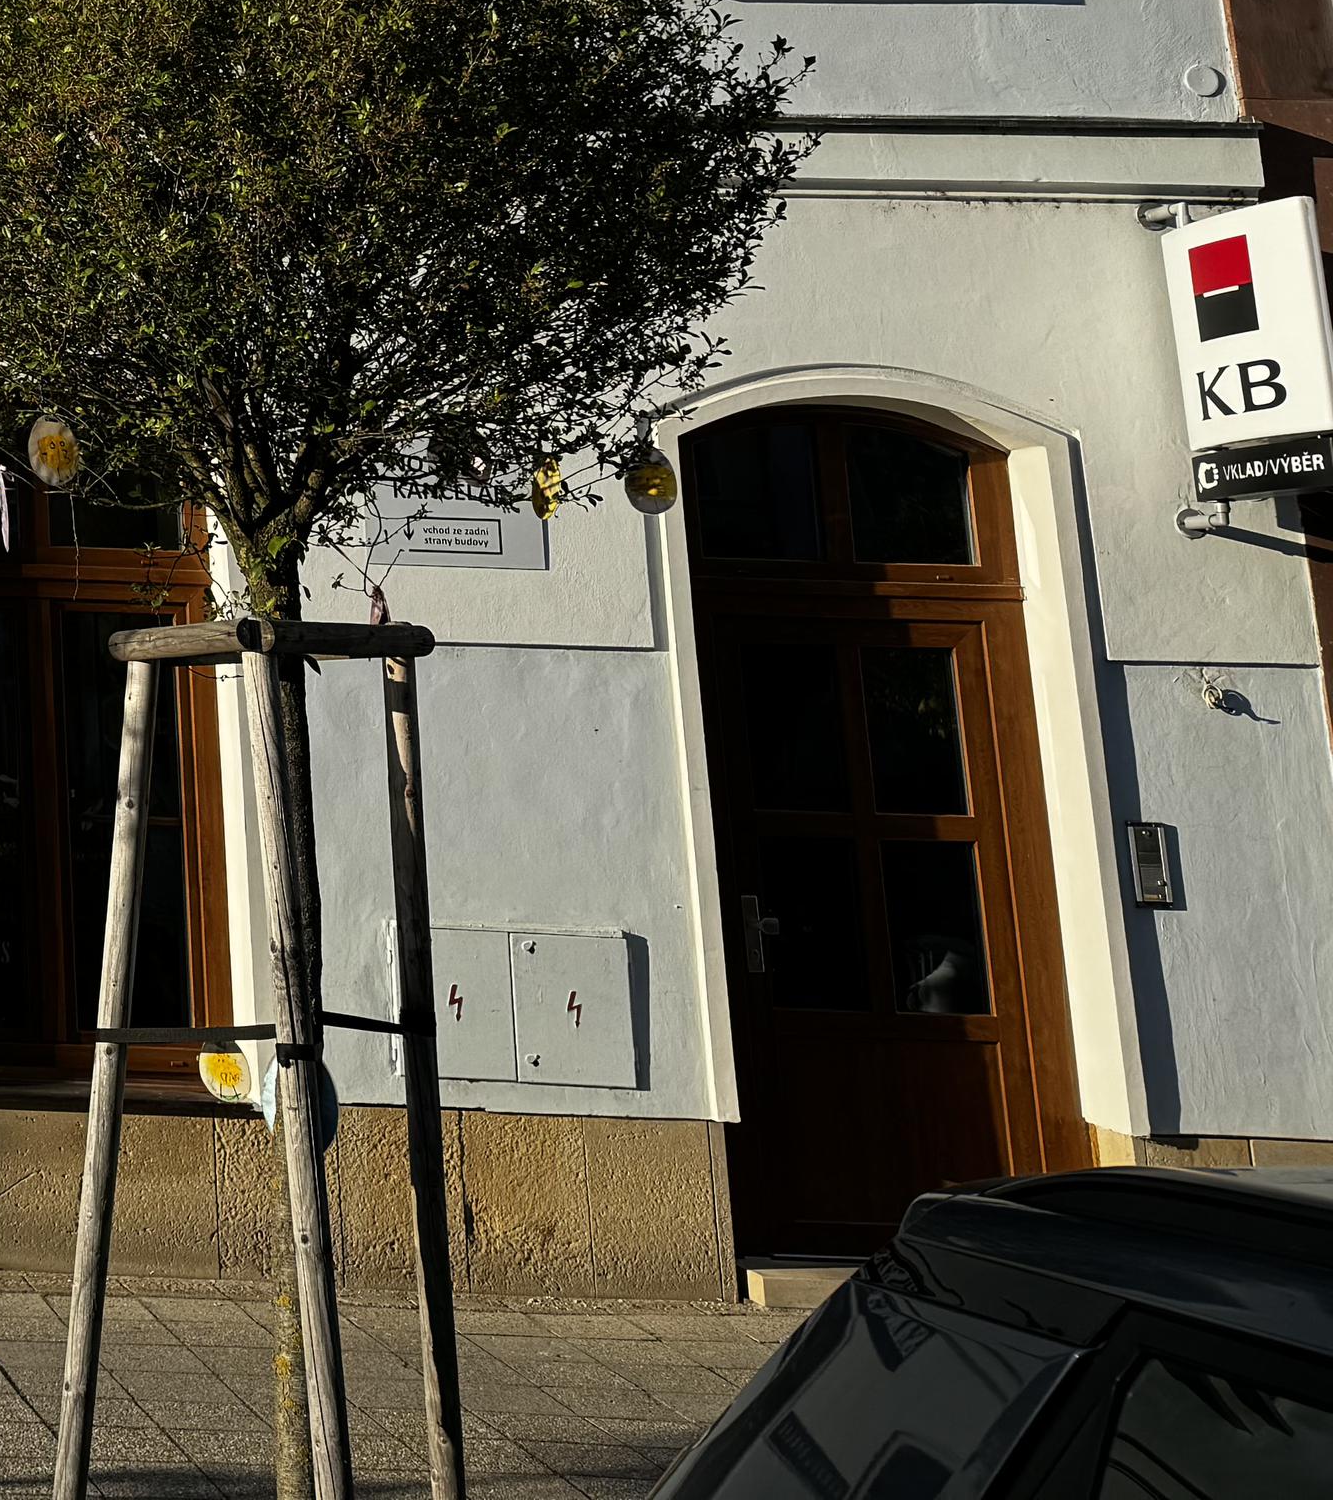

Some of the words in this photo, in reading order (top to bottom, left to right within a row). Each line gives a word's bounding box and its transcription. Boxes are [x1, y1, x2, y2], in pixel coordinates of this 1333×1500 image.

[1196, 358, 1287, 421] KB
[1222, 451, 1325, 481] VKLAD/VÝBĚR
[423, 526, 449, 535] vchod
[424, 538, 452, 548] strany
[454, 537, 489, 548] budovy
